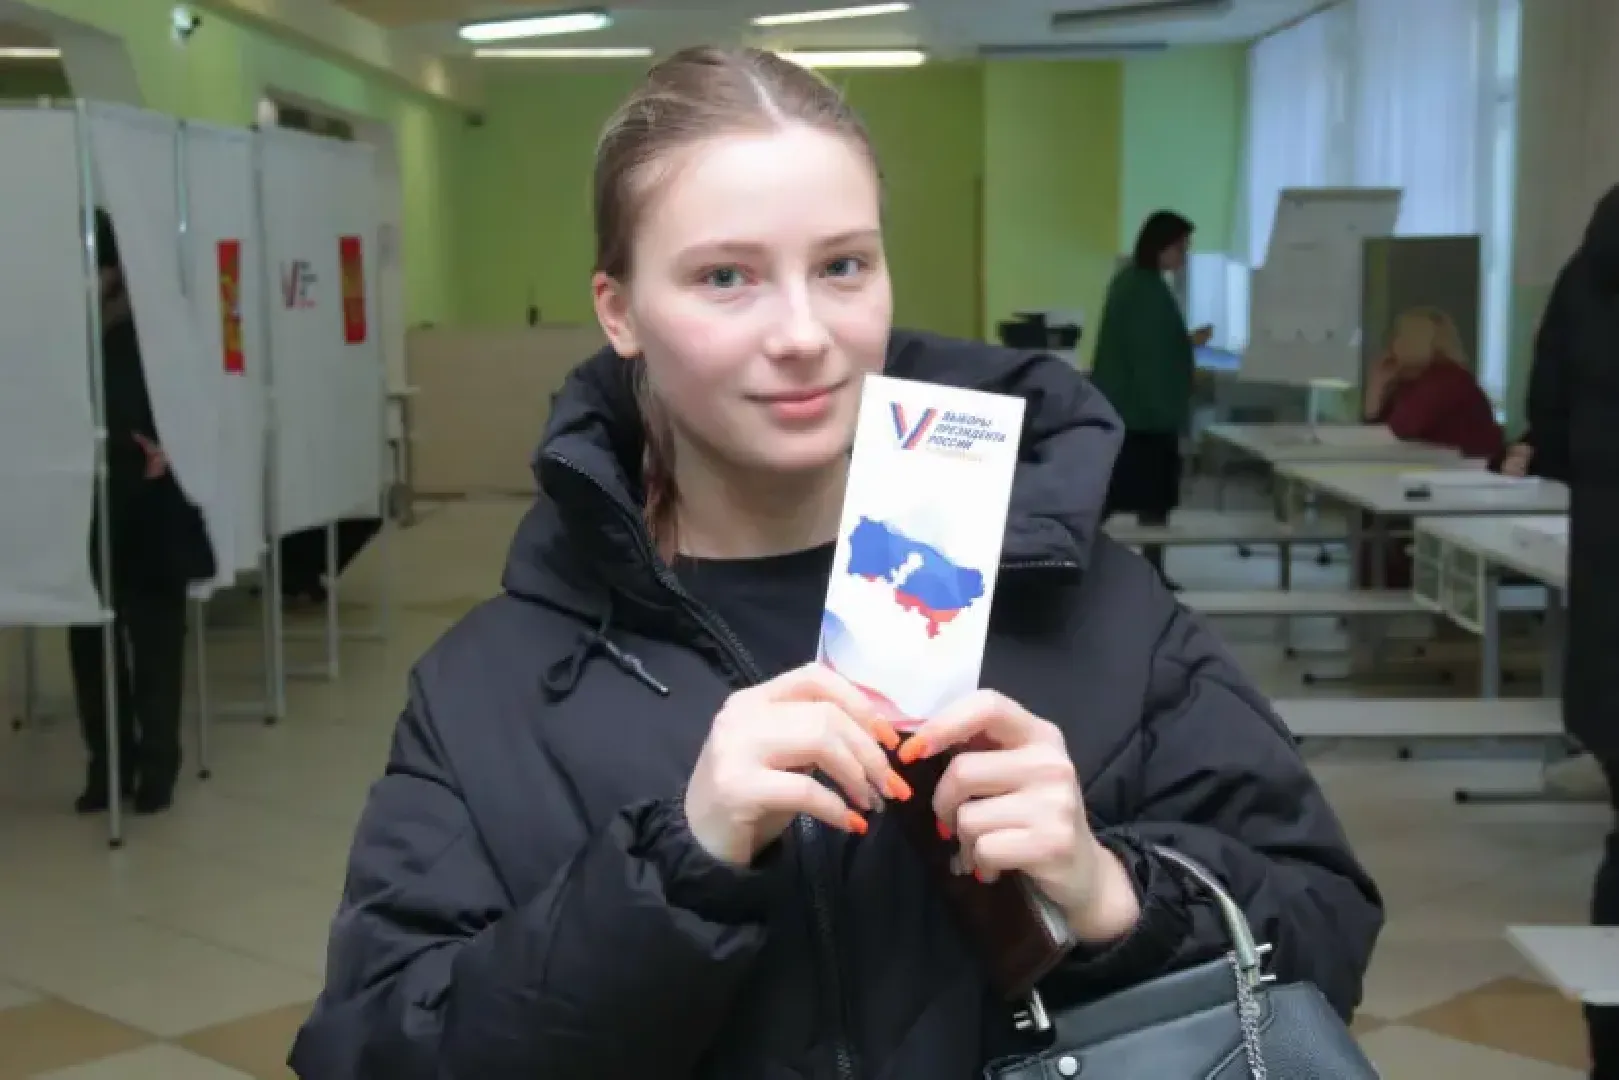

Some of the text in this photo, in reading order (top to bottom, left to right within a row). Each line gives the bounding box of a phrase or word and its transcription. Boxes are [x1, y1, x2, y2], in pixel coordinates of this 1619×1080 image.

[942, 410, 992, 428] ВЫБОРЫ
[934, 423, 1007, 442] ПРЕЗИДЕНТА
[927, 435, 974, 450] РОССИИ
